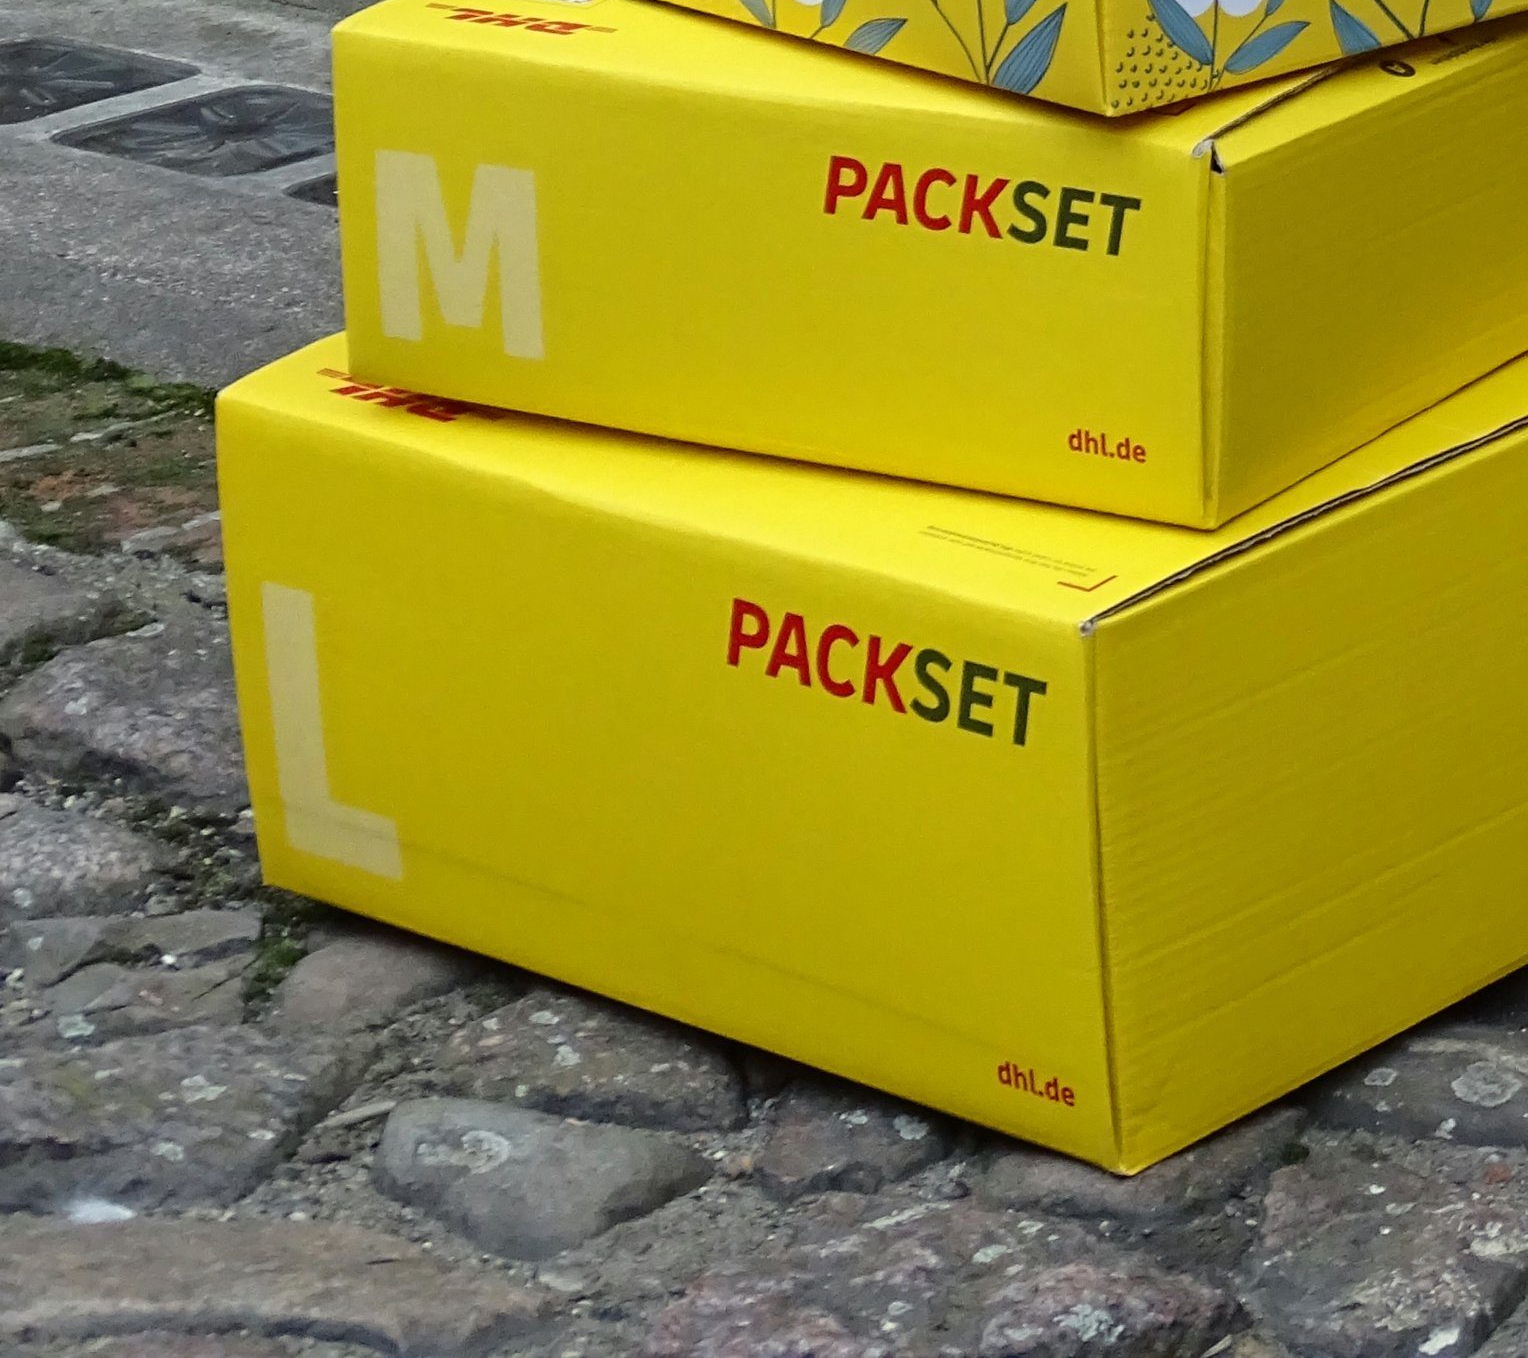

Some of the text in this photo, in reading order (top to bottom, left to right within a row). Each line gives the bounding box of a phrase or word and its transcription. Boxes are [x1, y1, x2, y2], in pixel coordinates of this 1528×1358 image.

[445, 8, 591, 35] DHL
[374, 149, 545, 361] M
[823, 155, 1142, 257] PACKSET
[1068, 429, 1146, 463] dhl.de
[727, 598, 1047, 746] PACKSET
[261, 581, 401, 881] L
[998, 1061, 1075, 1107] dhl.de
